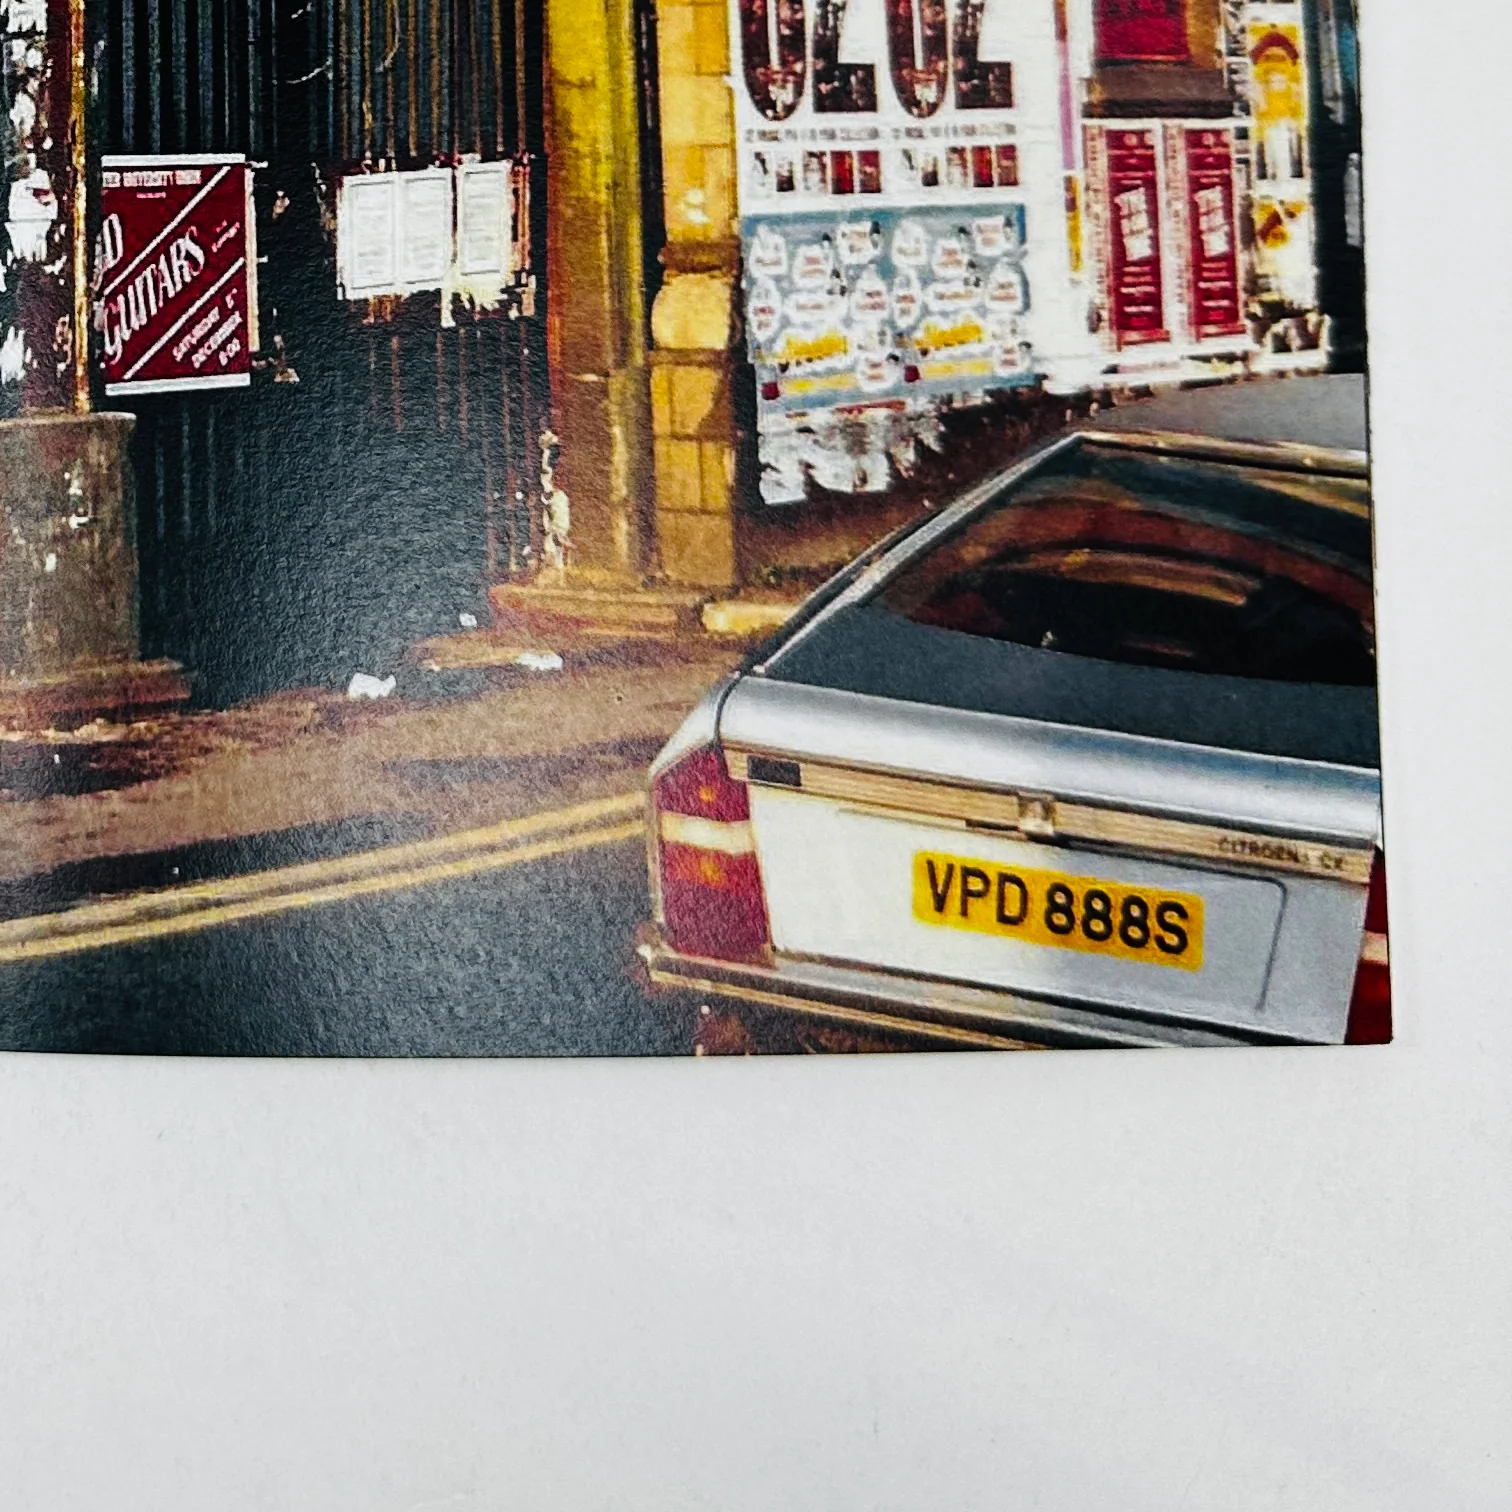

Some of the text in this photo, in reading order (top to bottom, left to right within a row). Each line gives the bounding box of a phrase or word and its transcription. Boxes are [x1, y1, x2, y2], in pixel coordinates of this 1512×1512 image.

[103, 224, 206, 366] GUITARS
[926, 858, 1189, 956] VPD 888S
